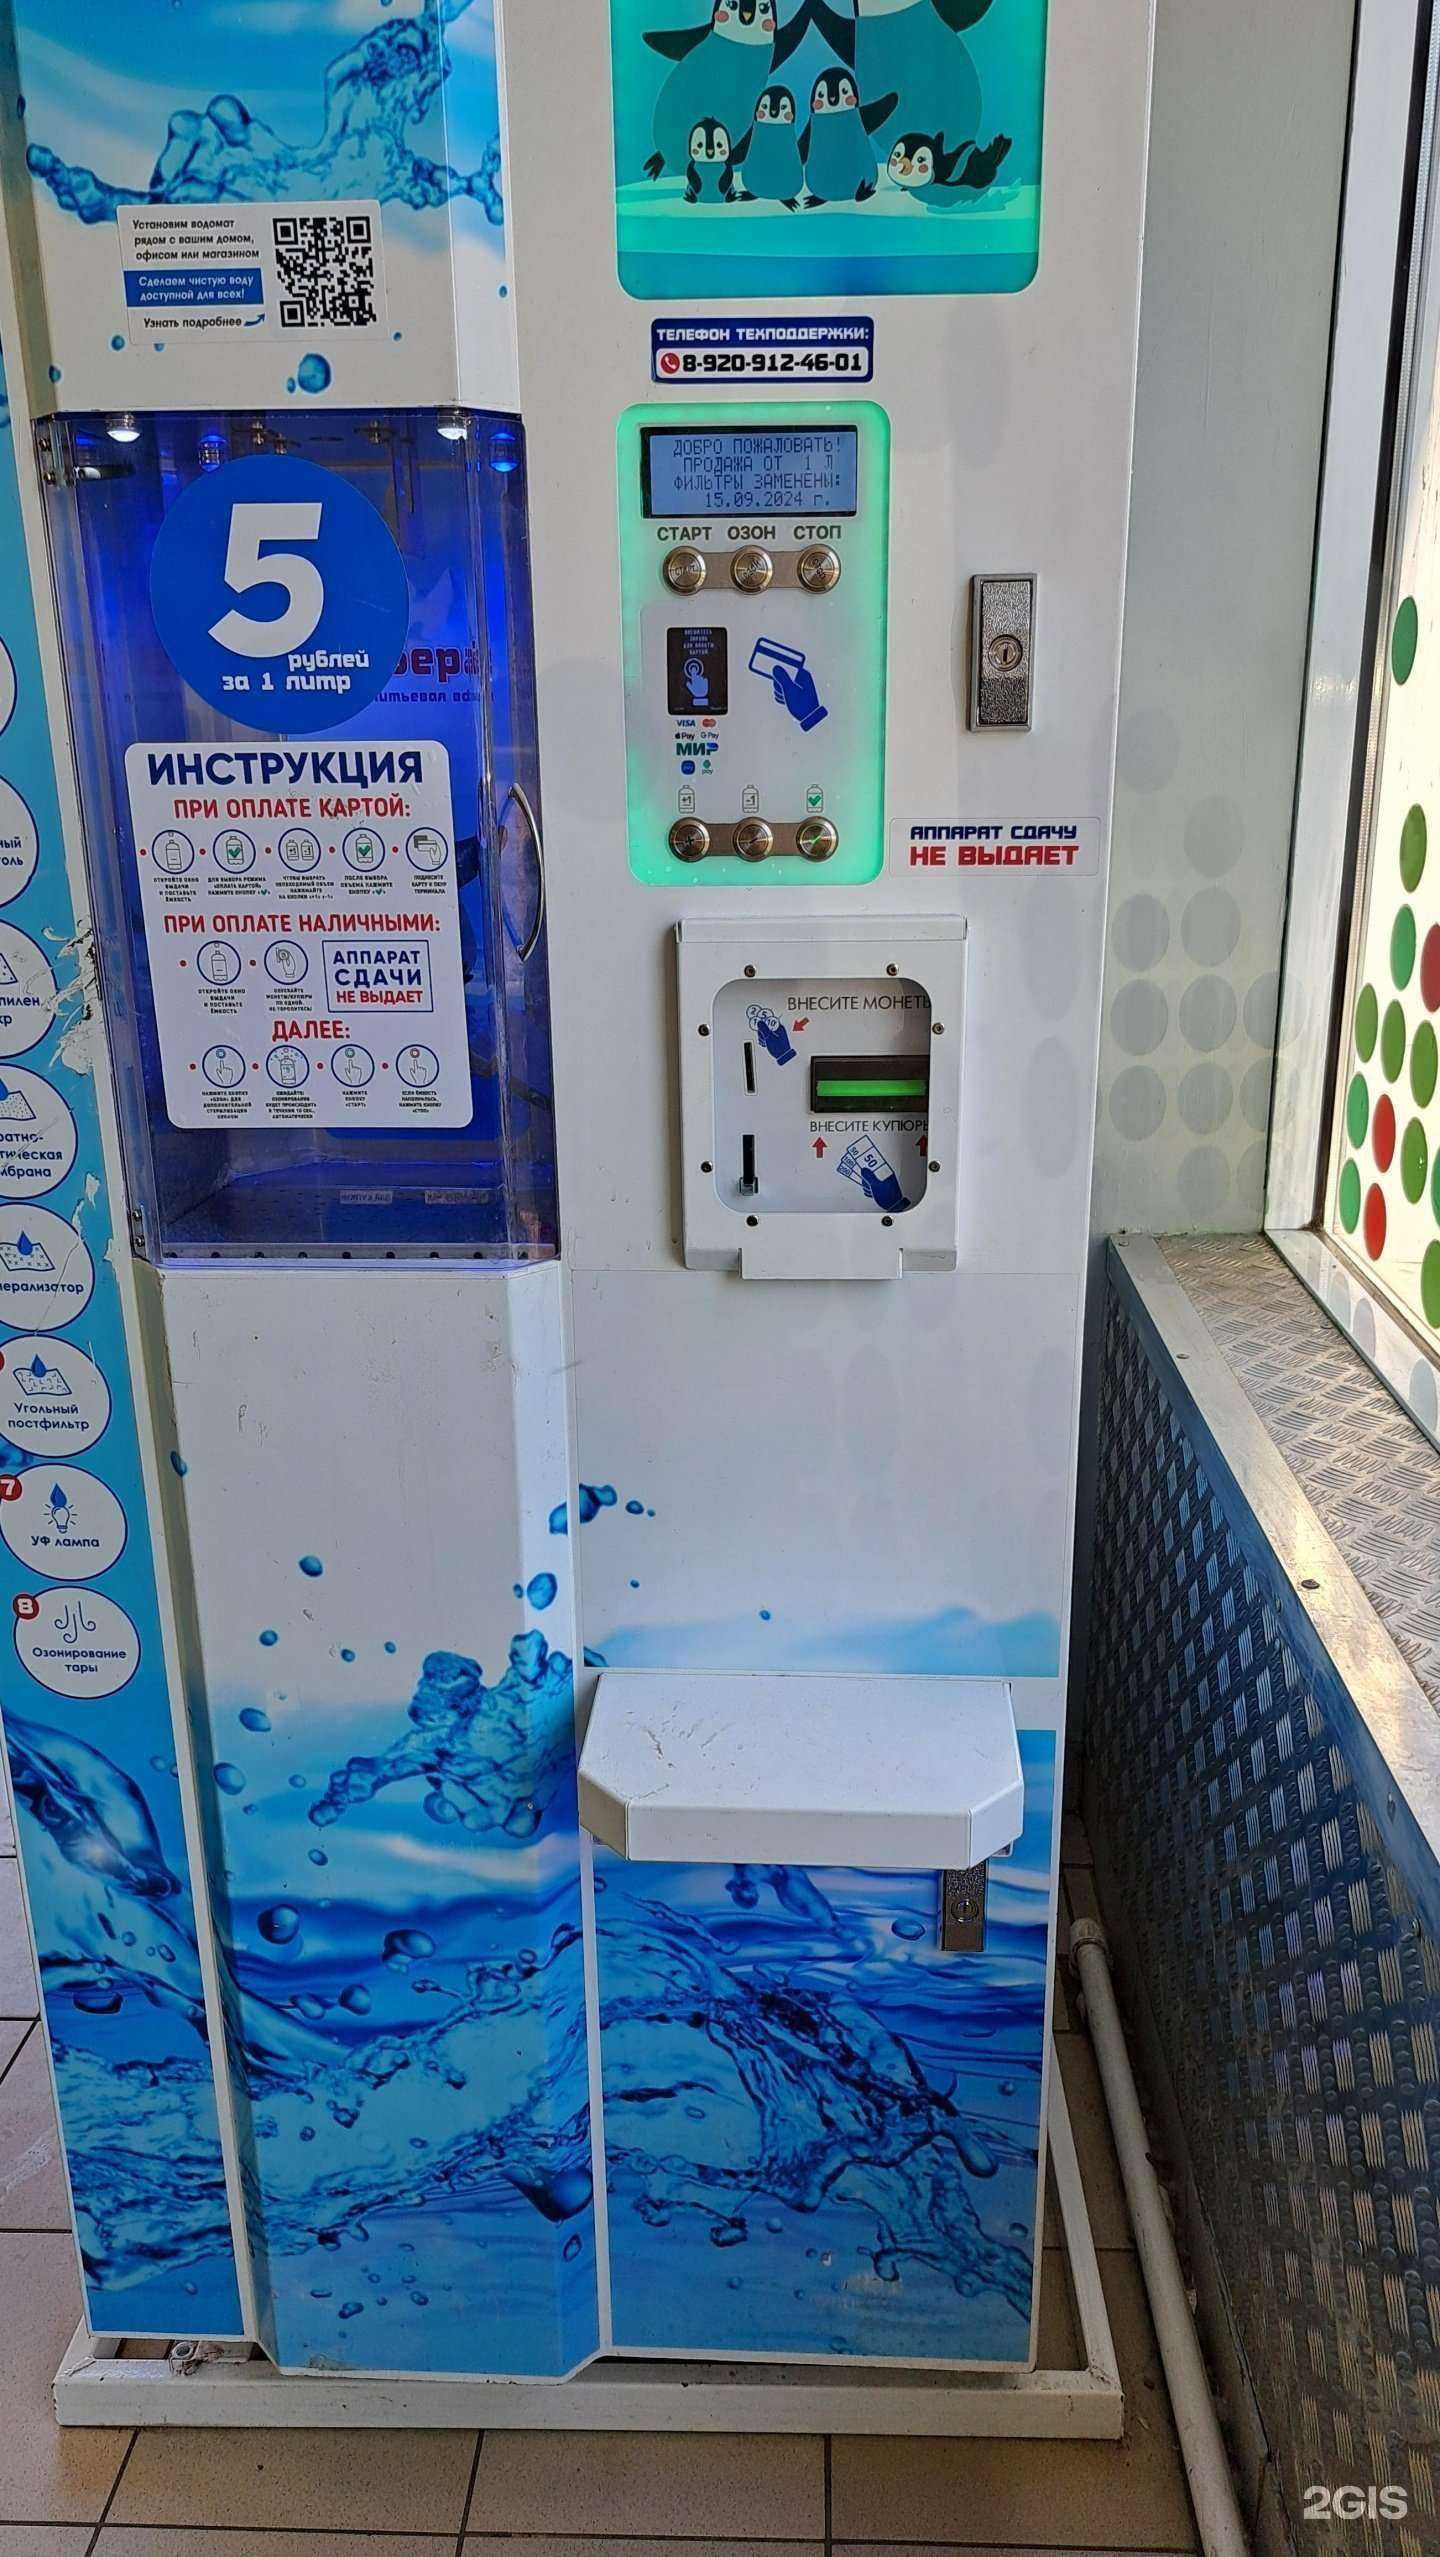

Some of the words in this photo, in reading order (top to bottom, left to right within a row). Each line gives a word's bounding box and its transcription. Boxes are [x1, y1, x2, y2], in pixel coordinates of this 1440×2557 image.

[133, 220, 188, 230] Установим
[191, 220, 235, 230] водомат
[134, 236, 166, 248] рядом
[179, 236, 214, 244] вашим
[216, 235, 254, 245] домом,
[136, 250, 178, 262] офисом
[181, 251, 199, 260] или
[203, 250, 260, 259] магазином
[139, 276, 186, 288] Сделаем
[189, 277, 226, 288] чистую
[230, 276, 254, 287] воду
[140, 290, 194, 302] доступной
[197, 292, 214, 300] для
[218, 288, 245, 300] всех!
[143, 318, 180, 328] Узнать
[182, 316, 242, 330] подробнее
[657, 329, 730, 341] ТЕЛЕФОН
[736, 327, 870, 341] ТЕХПОДДЕРЖКИ:
[682, 353, 862, 373] 8-920-912-46-01
[674, 439, 722, 458] ДОБРО
[733, 437, 841, 454] ПОЖАЛОВАТЬ!
[684, 457, 752, 477] ПРОДАЖА
[764, 456, 782, 470] ОТ
[806, 456, 811, 469] 1
[825, 455, 832, 469] Л
[674, 474, 743, 490] ФИЛЬТРЫ
[754, 473, 840, 490] ЗАМЕНЕНЫ:
[706, 491, 802, 508] 15.09.2024
[814, 494, 829, 506] г.
[656, 526, 712, 541] СТАРТ
[727, 526, 776, 540] ОЗОН
[793, 525, 842, 540] СТОП
[207, 502, 324, 658] 5
[288, 649, 369, 672] рублей
[222, 675, 250, 691] за
[262, 673, 274, 691] 1
[286, 675, 350, 694] литр
[677, 719, 696, 727] VISA
[682, 732, 696, 741] Pay
[676, 742, 719, 756] МИР
[148, 751, 423, 789] ИНСТРУКЦИЯ
[174, 799, 218, 819] ПРИ
[227, 798, 312, 818] ОПЛАТЕ
[320, 792, 412, 818] КАРТОЙ:
[910, 826, 1003, 840] АППАРАТ
[1010, 825, 1077, 840] СДАЧУ
[910, 846, 946, 866] НЕ
[958, 846, 1079, 866] ВЫДАЕТ
[164, 914, 205, 934] ПРИ
[212, 914, 291, 933] ОПЛАТЕ
[300, 913, 441, 933] НАЛИЧНЫМИ:
[332, 950, 421, 965] АППАРАТ
[334, 969, 422, 987] СДАЧИ
[336, 991, 356, 1004] НЕ
[360, 990, 424, 1004] ВЫДАЕТ
[788, 996, 858, 1011] ВНЕСИТЕ
[751, 1007, 756, 1015] 2
[272, 1020, 351, 1042] ДАЛЕЕ:
[810, 1120, 868, 1133] ВНЕСИТЕ
[864, 1154, 878, 1168] 50
[14, 1402, 79, 1414] Угольный
[8, 1418, 90, 1432] постфильтр
[1, 1480, 16, 1496] 7
[31, 1536, 50, 1546] УФ
[54, 1536, 100, 1548] лампа
[17, 1597, 34, 1614] 8
[32, 1647, 126, 1662] Озонирование
[64, 1664, 98, 1675] тары
